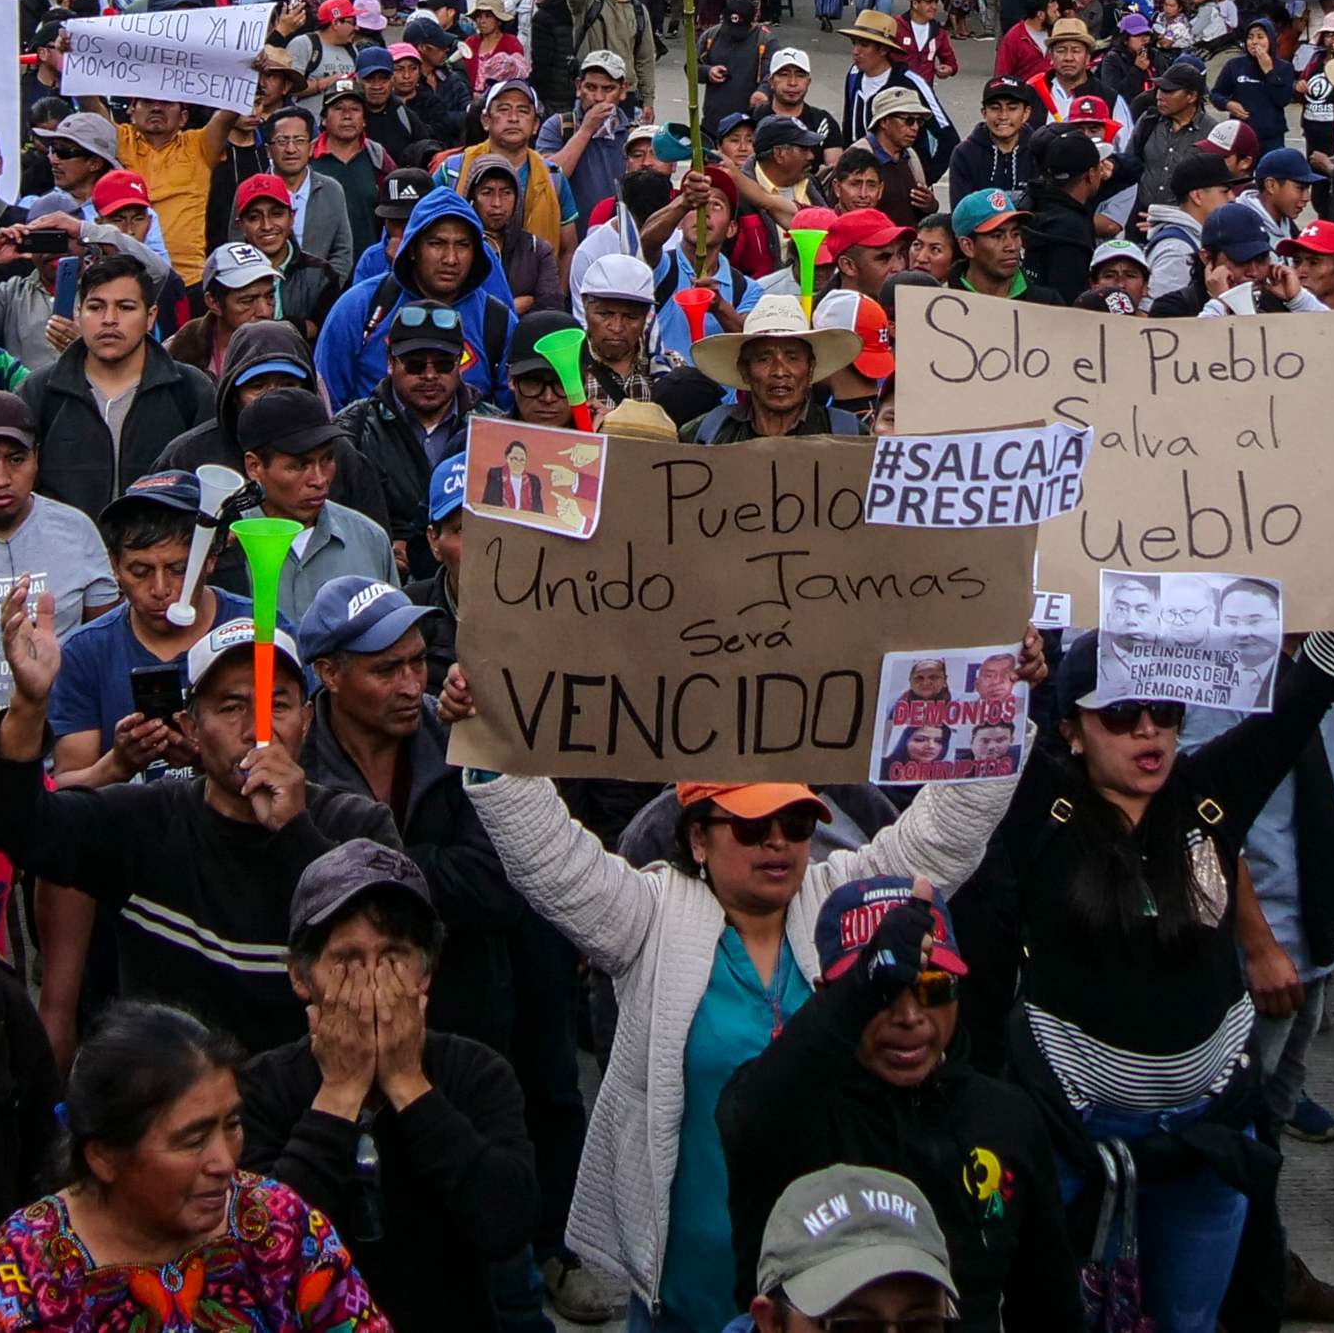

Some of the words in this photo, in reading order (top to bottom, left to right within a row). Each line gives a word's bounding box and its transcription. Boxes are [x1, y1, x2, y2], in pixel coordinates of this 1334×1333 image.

[117, 42, 204, 70] QUIERE
[205, 16, 227, 48] YA
[236, 21, 264, 52] NO
[66, 54, 141, 83] MOMOS
[160, 69, 257, 107] PRESENTE
[926, 295, 1051, 385] Solo
[1074, 327, 1108, 385] el
[1139, 327, 1306, 394] Pueblo
[1236, 396, 1281, 450] al
[654, 457, 866, 546] Pueblo
[867, 474, 1078, 526] PRESENTE
[485, 534, 675, 616] Unido
[737, 548, 988, 616] Jamas
[679, 617, 793, 657] Será
[1133, 644, 1240, 664] DELINCUENTES
[1131, 664, 1200, 681] ENEMIGOS
[1134, 680, 1230, 704] DEMOCRACIA
[499, 665, 864, 761] VENCIDO
[893, 696, 1017, 726] DEMONIOS
[889, 756, 1012, 781] CORRUPTOS
[803, 1196, 854, 1238] NEW
[861, 1189, 919, 1228] YORK
